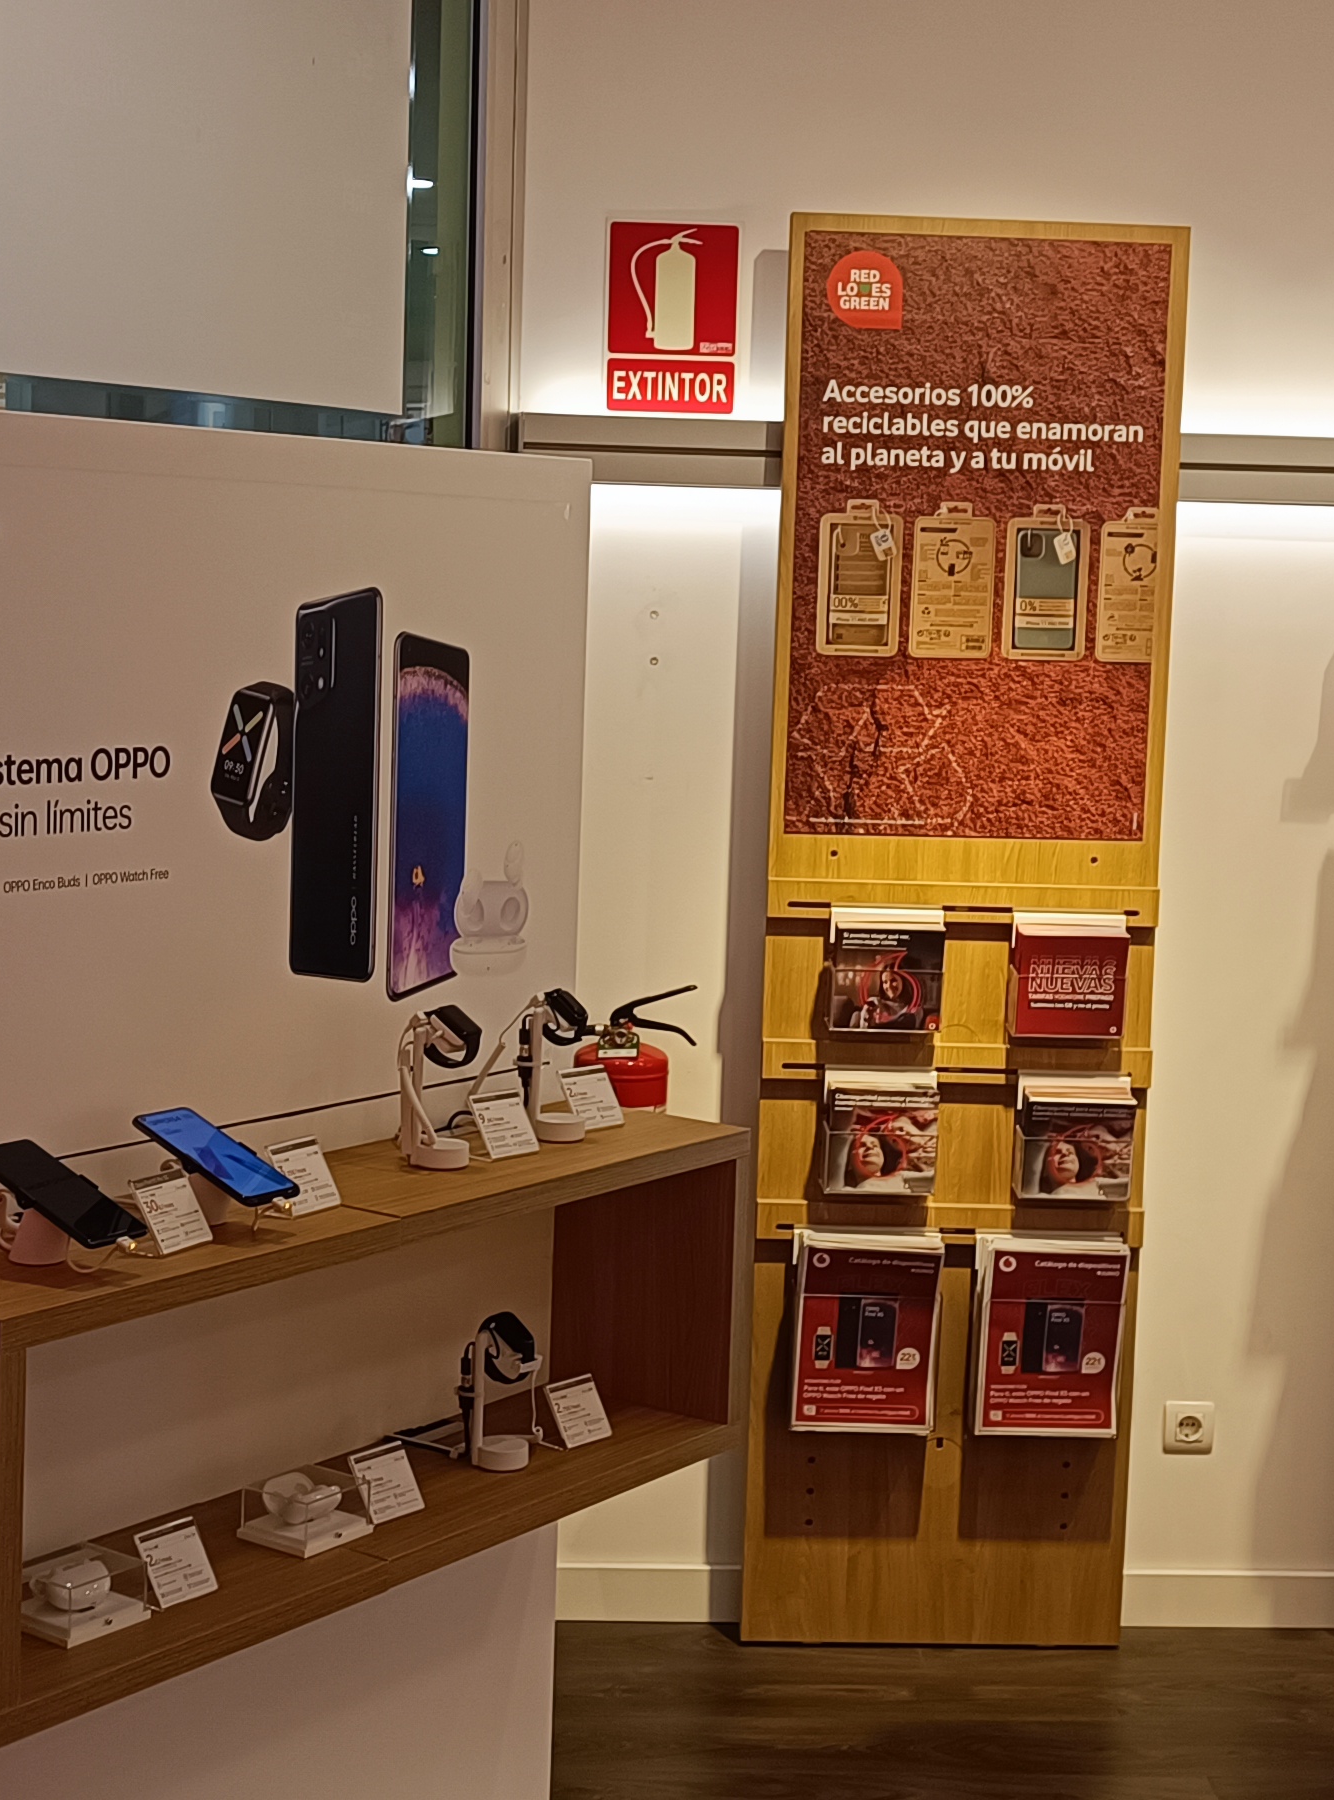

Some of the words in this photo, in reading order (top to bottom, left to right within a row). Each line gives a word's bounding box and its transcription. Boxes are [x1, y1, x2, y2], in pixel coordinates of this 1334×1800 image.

[850, 269, 880, 282] RED
[839, 296, 890, 311] GREEN
[612, 370, 727, 403] EXTINTOR
[822, 379, 960, 406] Accesorios
[968, 383, 1034, 408] 100%
[822, 412, 958, 437] reciclables
[964, 420, 1011, 443] que
[1017, 421, 1143, 443] enamoran
[821, 442, 844, 465] al
[850, 443, 945, 470] planeta
[949, 451, 966, 473] y
[970, 452, 985, 469] a
[991, 448, 1017, 469] tu
[1022, 448, 1094, 471] móvil
[90, 746, 171, 781] OPPO
[46, 799, 132, 835] límites
[3, 879, 30, 893] OPPO
[33, 878, 55, 891] Enco
[57, 876, 81, 889] Buds
[92, 871, 118, 886] OPPO
[120, 870, 148, 883] Watch
[150, 868, 169, 881] Free
[1028, 975, 1115, 993] NUEVAS
